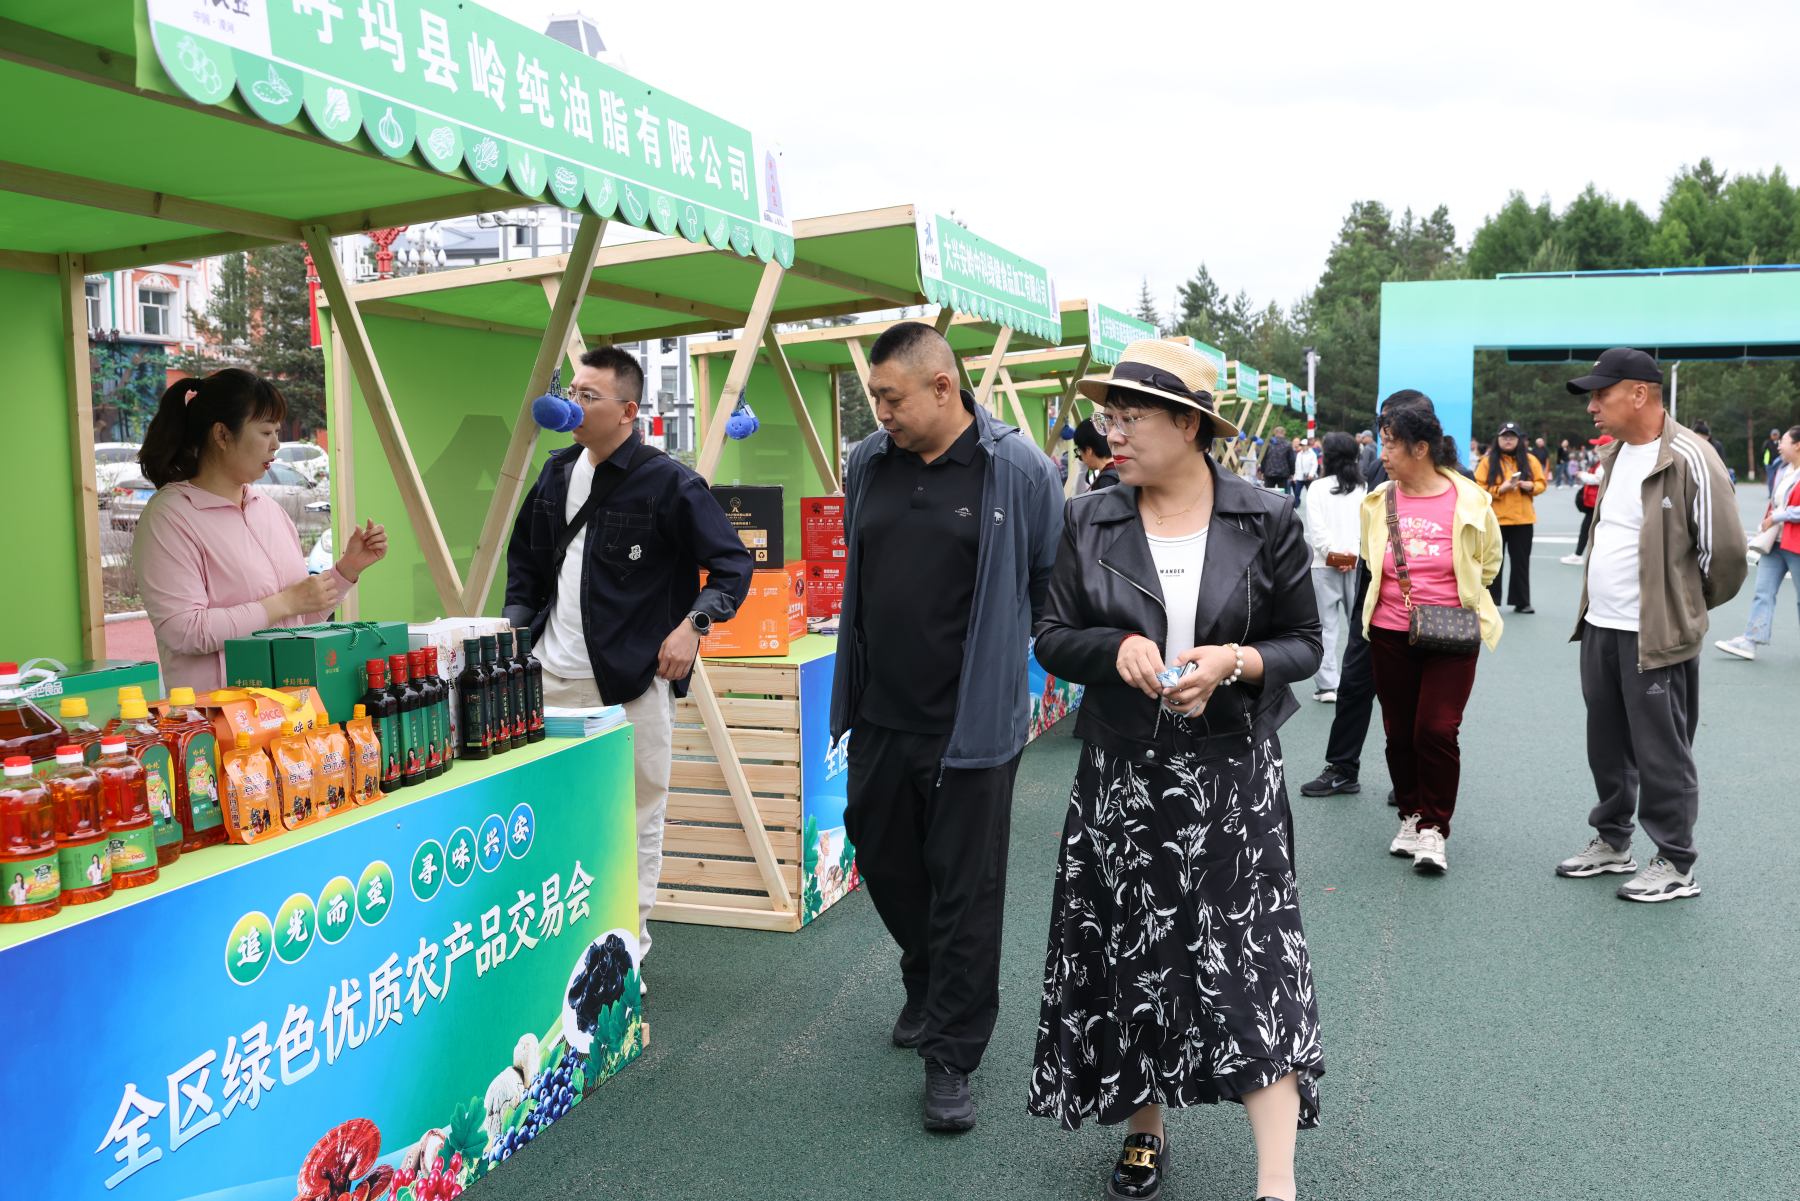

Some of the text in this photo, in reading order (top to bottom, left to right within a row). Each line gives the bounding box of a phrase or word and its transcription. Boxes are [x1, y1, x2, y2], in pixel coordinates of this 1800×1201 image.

[1398, 517, 1443, 535] RIGHT
[236, 814, 530, 968] 追光而至 寻味兴安
[95, 860, 596, 1190] 全区绿色优质农产品交易会
